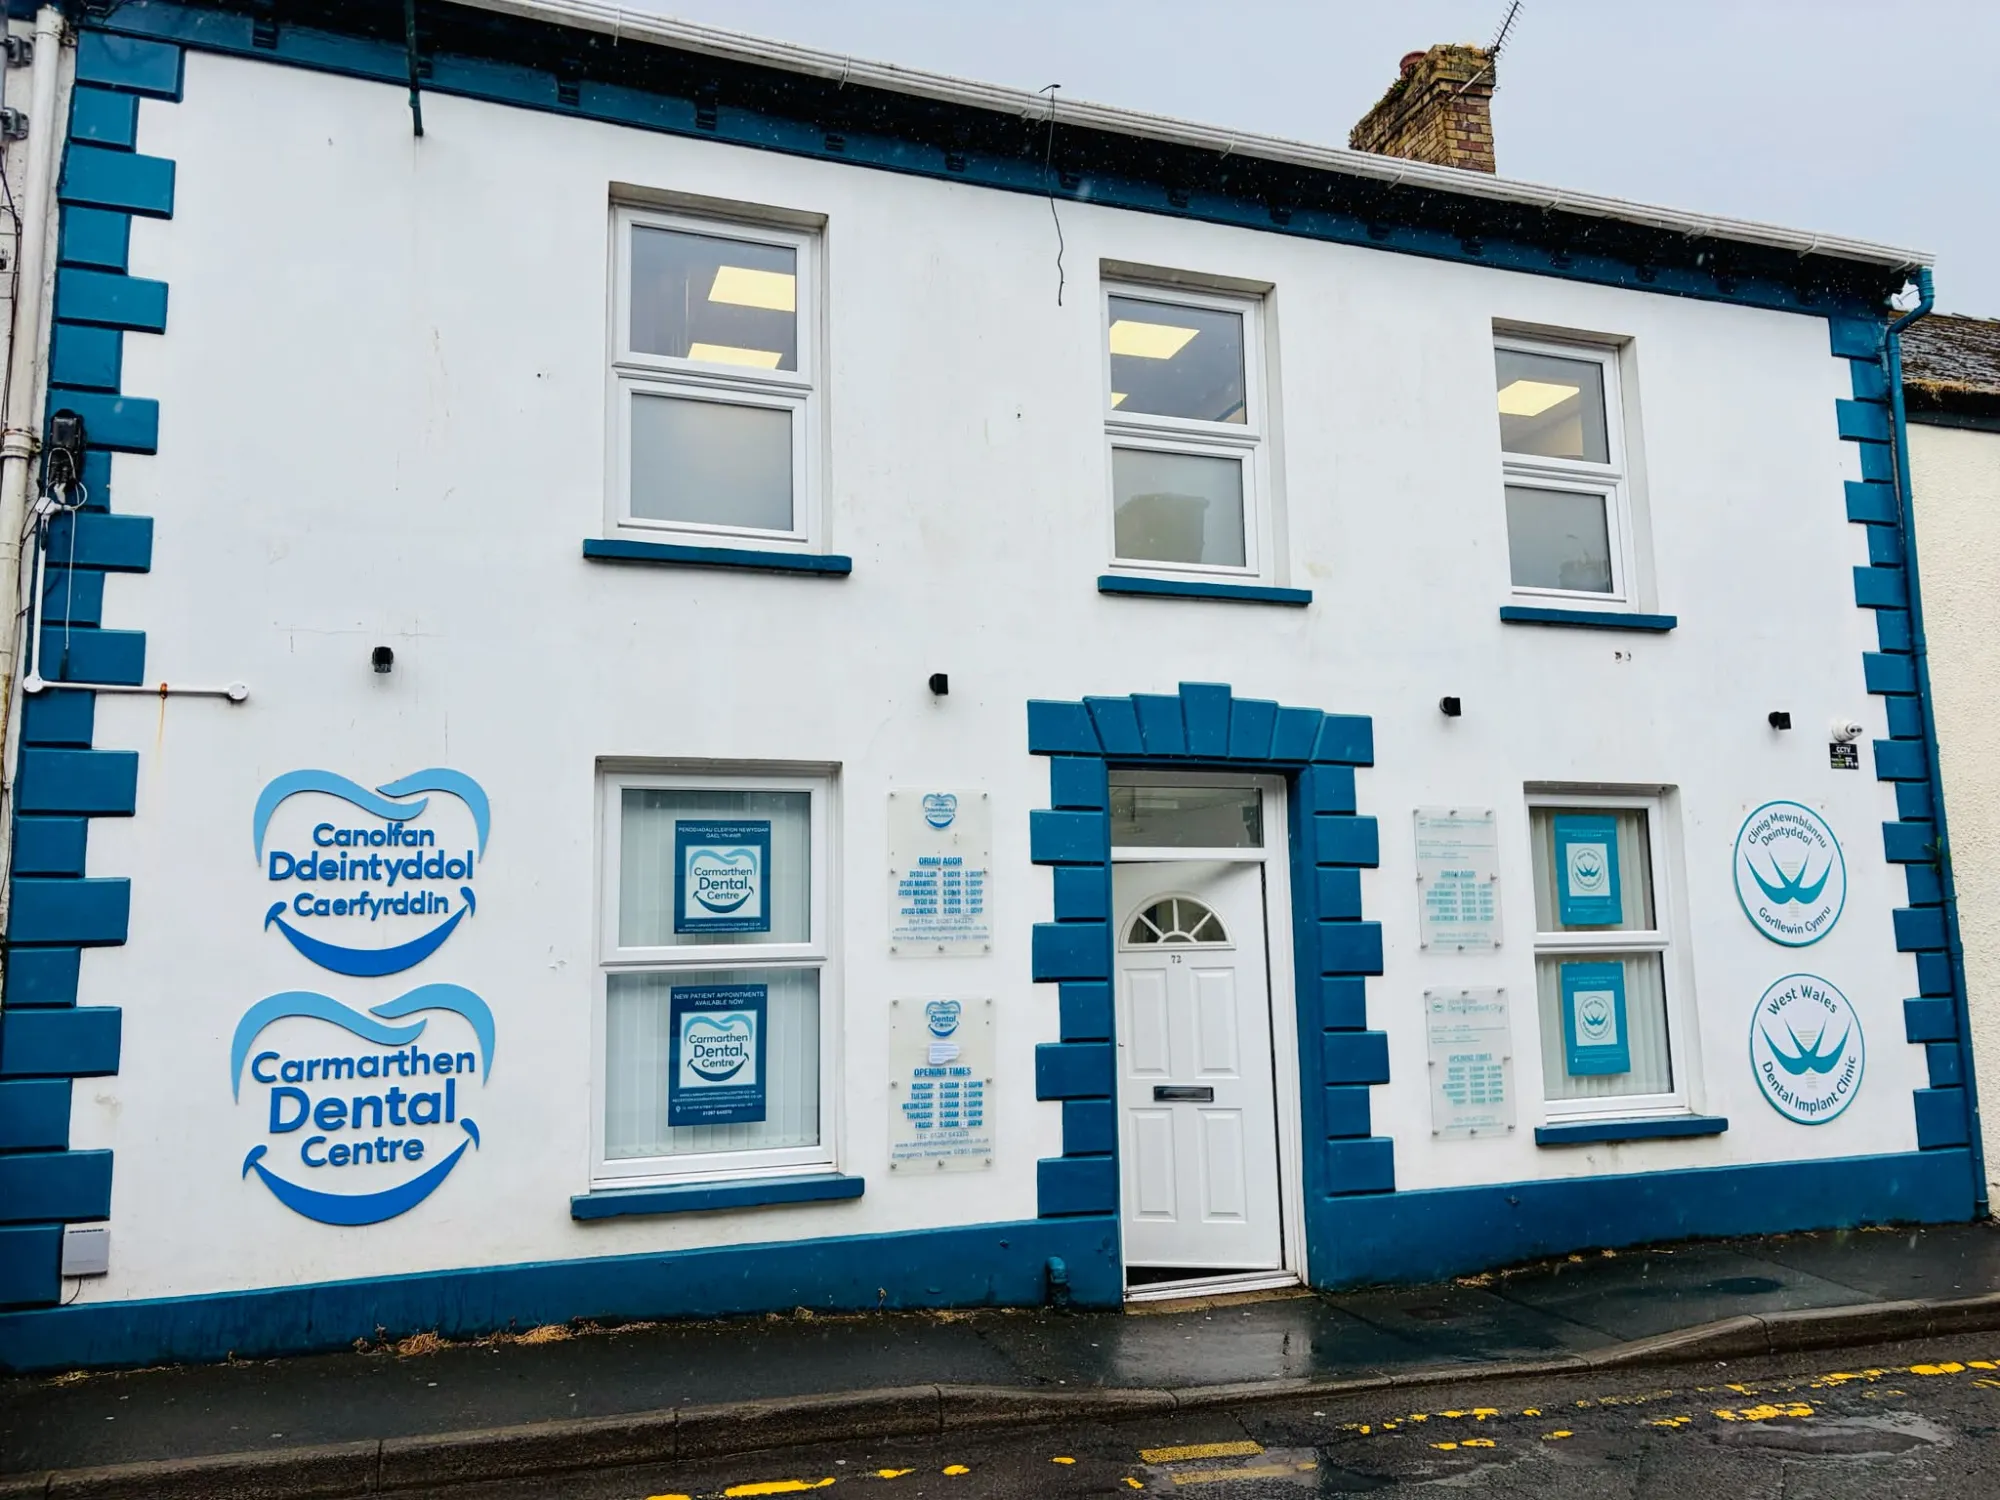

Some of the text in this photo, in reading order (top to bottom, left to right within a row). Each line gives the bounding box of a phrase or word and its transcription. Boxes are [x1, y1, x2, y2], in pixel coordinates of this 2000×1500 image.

[313, 822, 435, 847] Canolfan
[1748, 812, 1827, 849] Clinig Mewnblannu
[1761, 827, 1813, 847] Deintyddol
[269, 850, 473, 886] Ddeintyddol
[694, 866, 753, 877] Carmarthen
[699, 876, 748, 890] Dental
[707, 891, 740, 900] Centre
[293, 890, 449, 921] Caerfyrddin
[1759, 906, 1831, 935] Gorllewin Cymru
[1767, 984, 1838, 1016] West Wales
[689, 1032, 748, 1044] Carmarthen
[694, 1043, 743, 1058] Dental
[252, 1045, 475, 1083] Carmarthen
[701, 1058, 735, 1068] Centre
[914, 1067, 971, 1077] OPENING TIMES
[1762, 1055, 1857, 1116] Dental Implant Clinic
[269, 1078, 456, 1133] Dental
[301, 1136, 424, 1167] Centre
